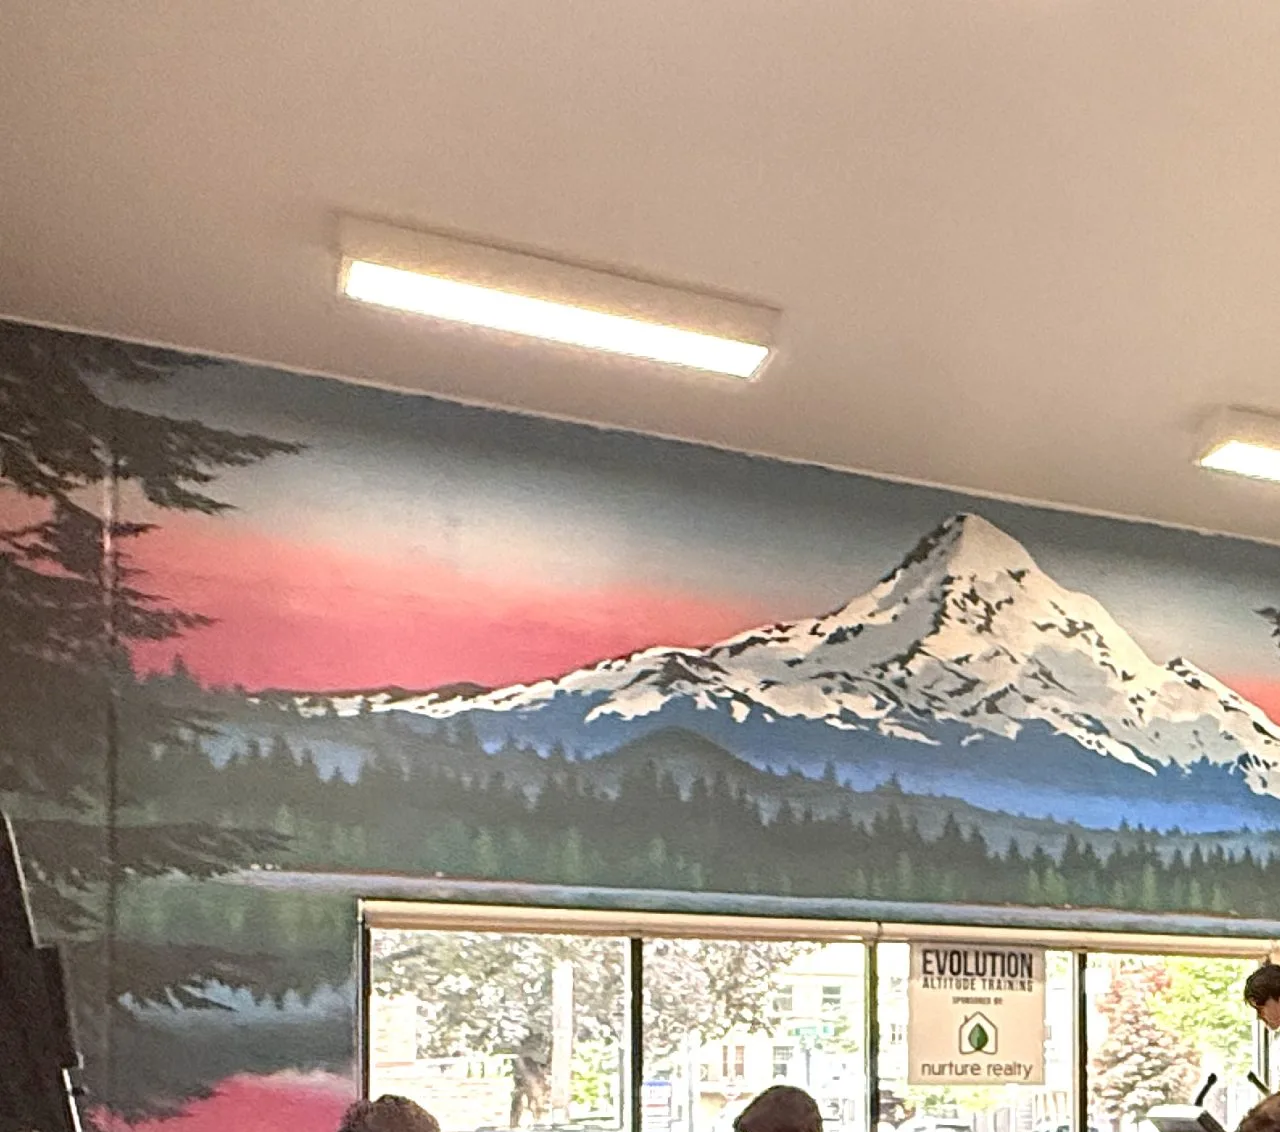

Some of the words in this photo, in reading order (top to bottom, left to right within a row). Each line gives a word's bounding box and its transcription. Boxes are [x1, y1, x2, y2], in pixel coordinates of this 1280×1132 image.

[922, 949, 1033, 979] EVOLUTION
[922, 976, 976, 991] ALTITUDE
[981, 978, 1033, 993] TRAINING
[921, 1060, 981, 1076] nurture
[987, 1062, 1033, 1080] realty
